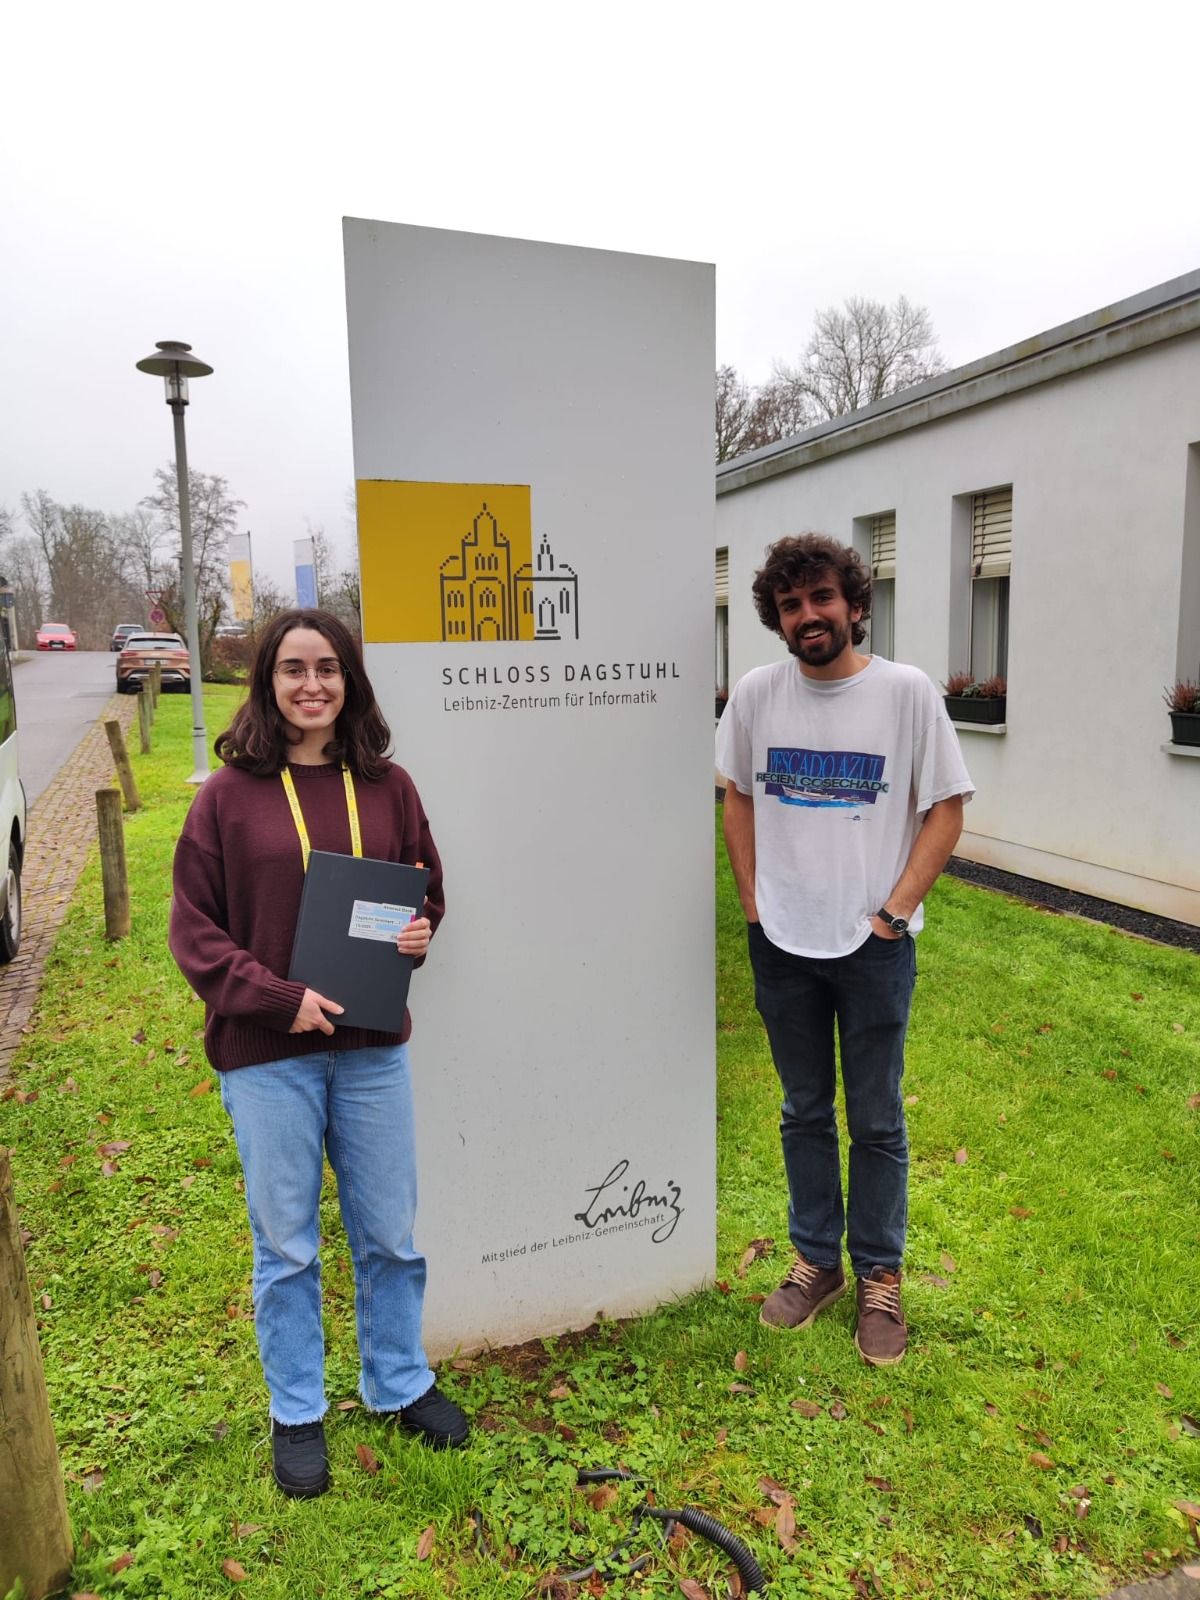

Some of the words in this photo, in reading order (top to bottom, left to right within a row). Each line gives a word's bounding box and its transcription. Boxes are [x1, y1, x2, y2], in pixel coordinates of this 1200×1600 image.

[442, 665, 550, 685] SCHLOSS
[565, 662, 680, 682] DAGSTUHL
[444, 694, 560, 711] Leibniz-Zentrum
[565, 692, 584, 707] für
[588, 689, 657, 706] Informatik
[756, 772, 796, 785] RECIEN
[800, 776, 889, 793] COSECHADO
[481, 1245, 527, 1264] Mitglied
[530, 1240, 548, 1252] der
[552, 1213, 666, 1247] Leibniz-Gemeinschaft
